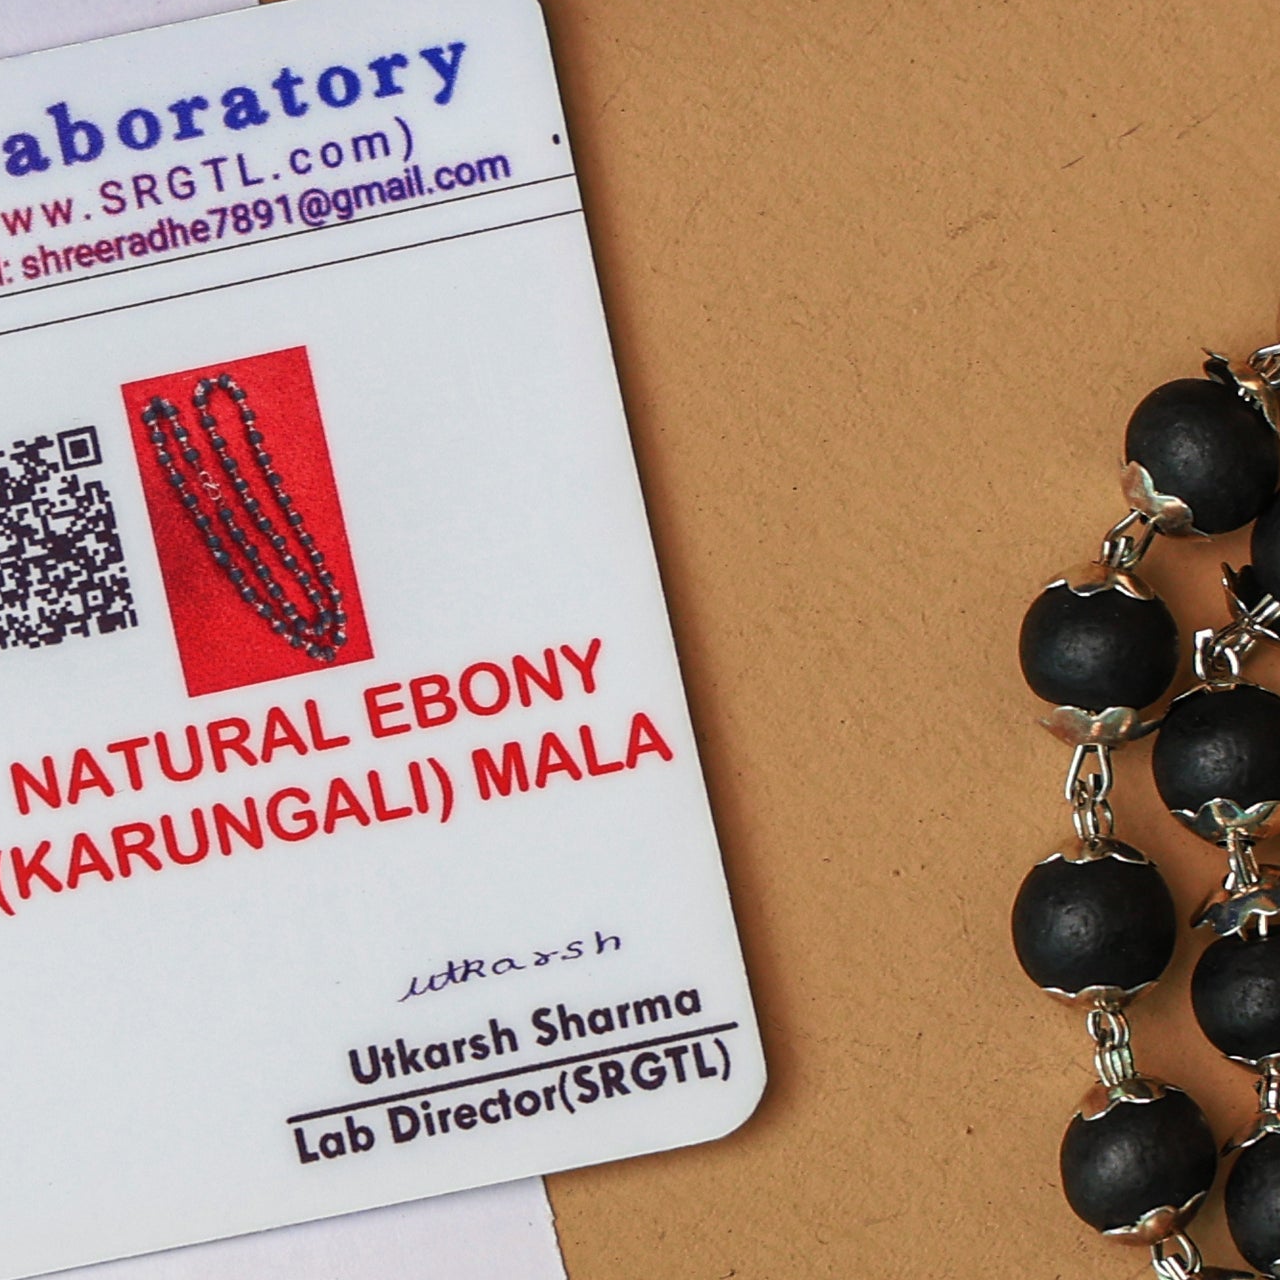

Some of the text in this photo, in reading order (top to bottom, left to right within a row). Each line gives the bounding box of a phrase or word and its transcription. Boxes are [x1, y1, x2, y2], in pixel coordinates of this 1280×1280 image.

[21, 154, 511, 280] shreeradhe7891@gmail.com
[8, 636, 602, 816] NATURAL EBONY
[469, 711, 674, 801] MALA
[346, 987, 702, 1086] Utkarsh Sharma
[293, 1036, 733, 1165] Lab Director(SRGTL)
